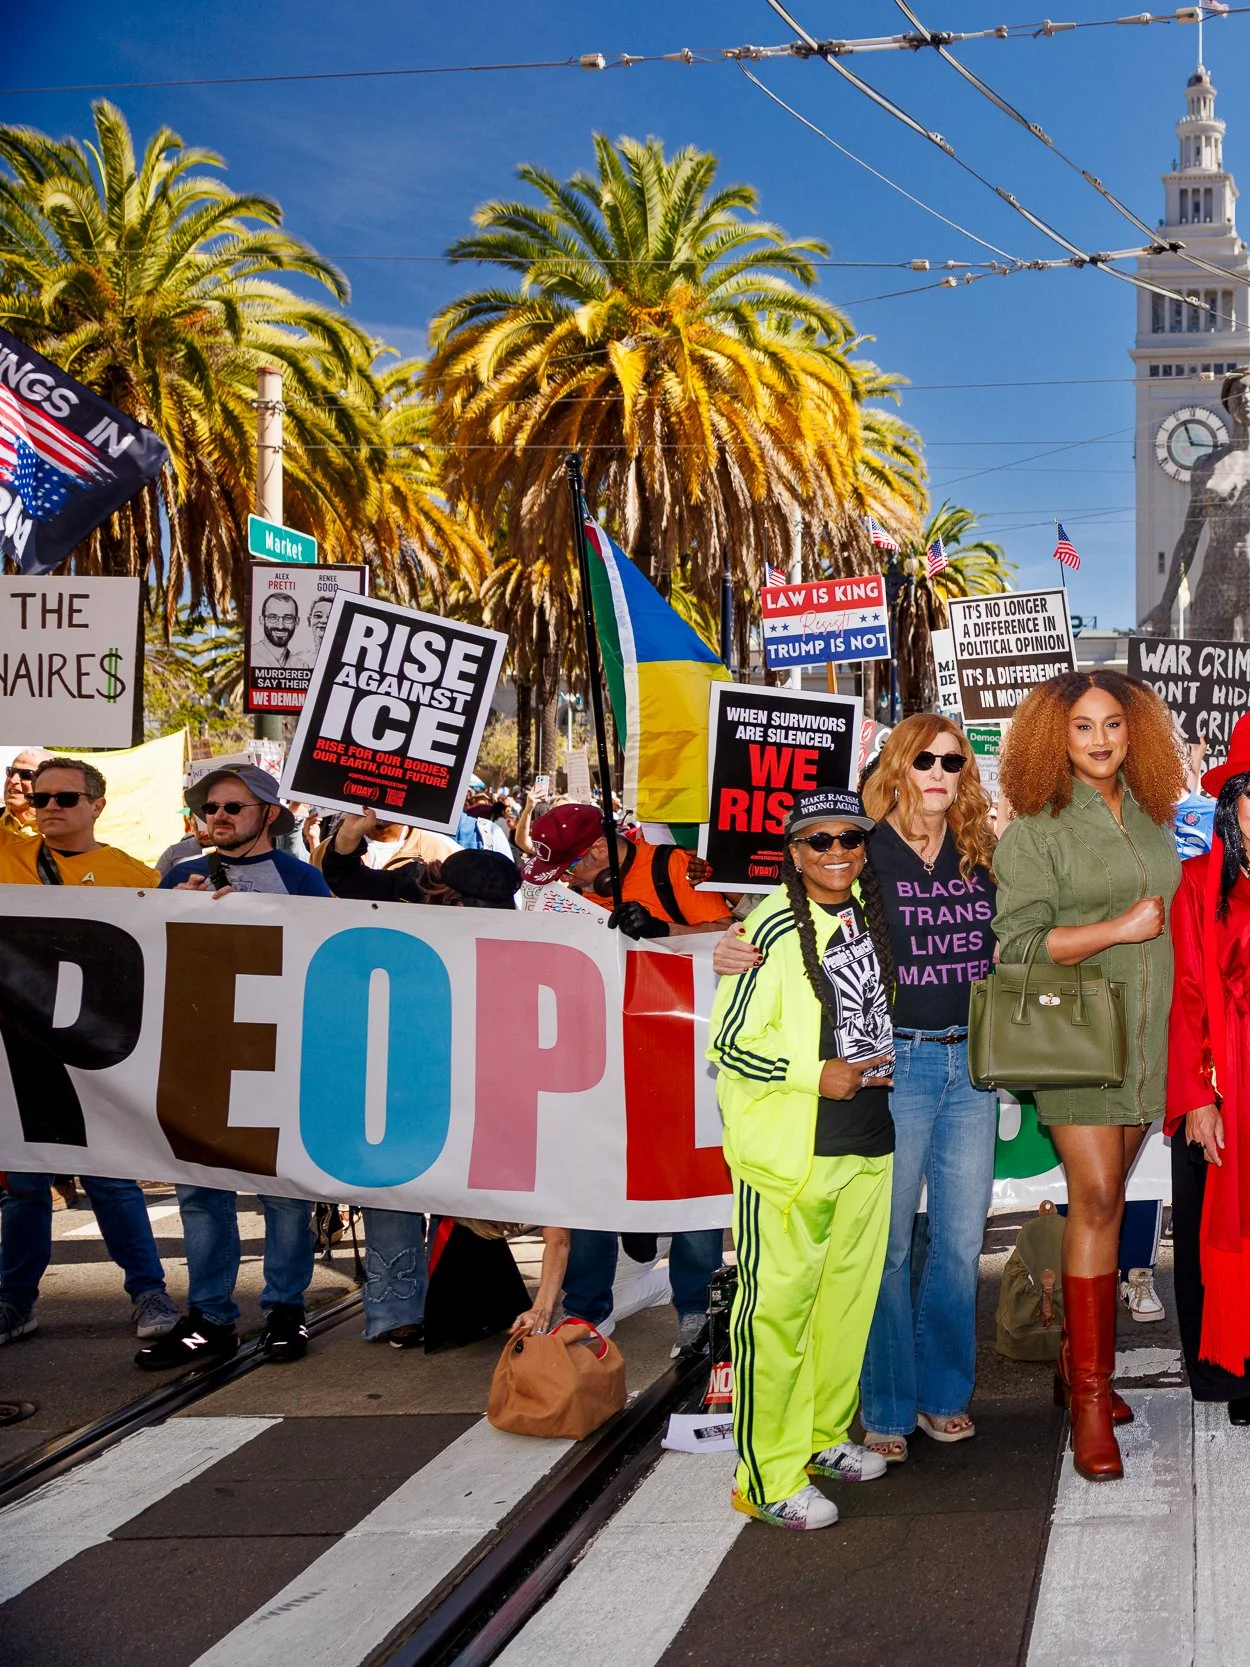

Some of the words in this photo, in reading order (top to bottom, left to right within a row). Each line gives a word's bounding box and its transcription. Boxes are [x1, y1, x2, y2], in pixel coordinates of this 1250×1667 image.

[0, 343, 79, 418] INGS
[84, 416, 135, 458] IN
[265, 530, 303, 561] Market
[268, 580, 296, 591] PRETTI
[274, 572, 290, 580] ALEX
[317, 582, 339, 592] GOOD
[766, 590, 806, 609] LAW
[812, 588, 829, 605] IS
[835, 582, 879, 601] KING
[10, 592, 90, 629] THE
[962, 603, 982, 620] IT'S
[985, 601, 1001, 618] NO
[1004, 597, 1048, 617] LONGER
[963, 623, 971, 638] A
[973, 617, 1040, 638] DIFFERENCE
[1043, 615, 1057, 632] IN
[341, 613, 484, 695] RISE
[767, 640, 825, 659] TRUMP
[830, 637, 846, 653] IS
[850, 632, 886, 650] NOT
[959, 638, 1013, 657] POLITICAL
[1015, 633, 1066, 653] OPINION
[1139, 642, 1192, 675] WAR
[255, 669, 311, 679] MURDERED
[257, 679, 277, 688] SAY
[280, 679, 309, 689] THEIR
[940, 673, 956, 686] DE
[962, 667, 983, 686] IT'S
[986, 667, 996, 685] A
[252, 692, 269, 706] WE
[270, 692, 307, 707] DEMAN
[334, 666, 471, 713] AGAINST
[942, 692, 958, 706] KI
[980, 690, 995, 708] IN
[319, 684, 466, 767] ICE
[726, 707, 768, 725] WHEN
[771, 713, 846, 732] SURVIVORS
[735, 725, 764, 741] ARE
[767, 729, 835, 751] SILENCED,
[970, 733, 1000, 742] Democ
[313, 749, 338, 764] OUR
[340, 756, 379, 774] EARTH,
[380, 764, 403, 779] OUR
[405, 770, 449, 788] FUTURE
[316, 738, 346, 755] RISE
[348, 746, 374, 760] FOR
[376, 752, 402, 767] OUR
[404, 758, 451, 779] BODIES,
[749, 743, 819, 790] WE
[717, 788, 795, 835] RIS
[800, 793, 827, 807] MAKE
[827, 793, 860, 806] RACISM
[801, 802, 834, 815] WRONG
[836, 802, 860, 814] AGAIN
[896, 876, 986, 897] BLACK
[899, 901, 992, 926] TRANS
[910, 930, 983, 955] LIVES
[898, 960, 989, 985] MATTER
[0, 916, 734, 1201] PEOPL
